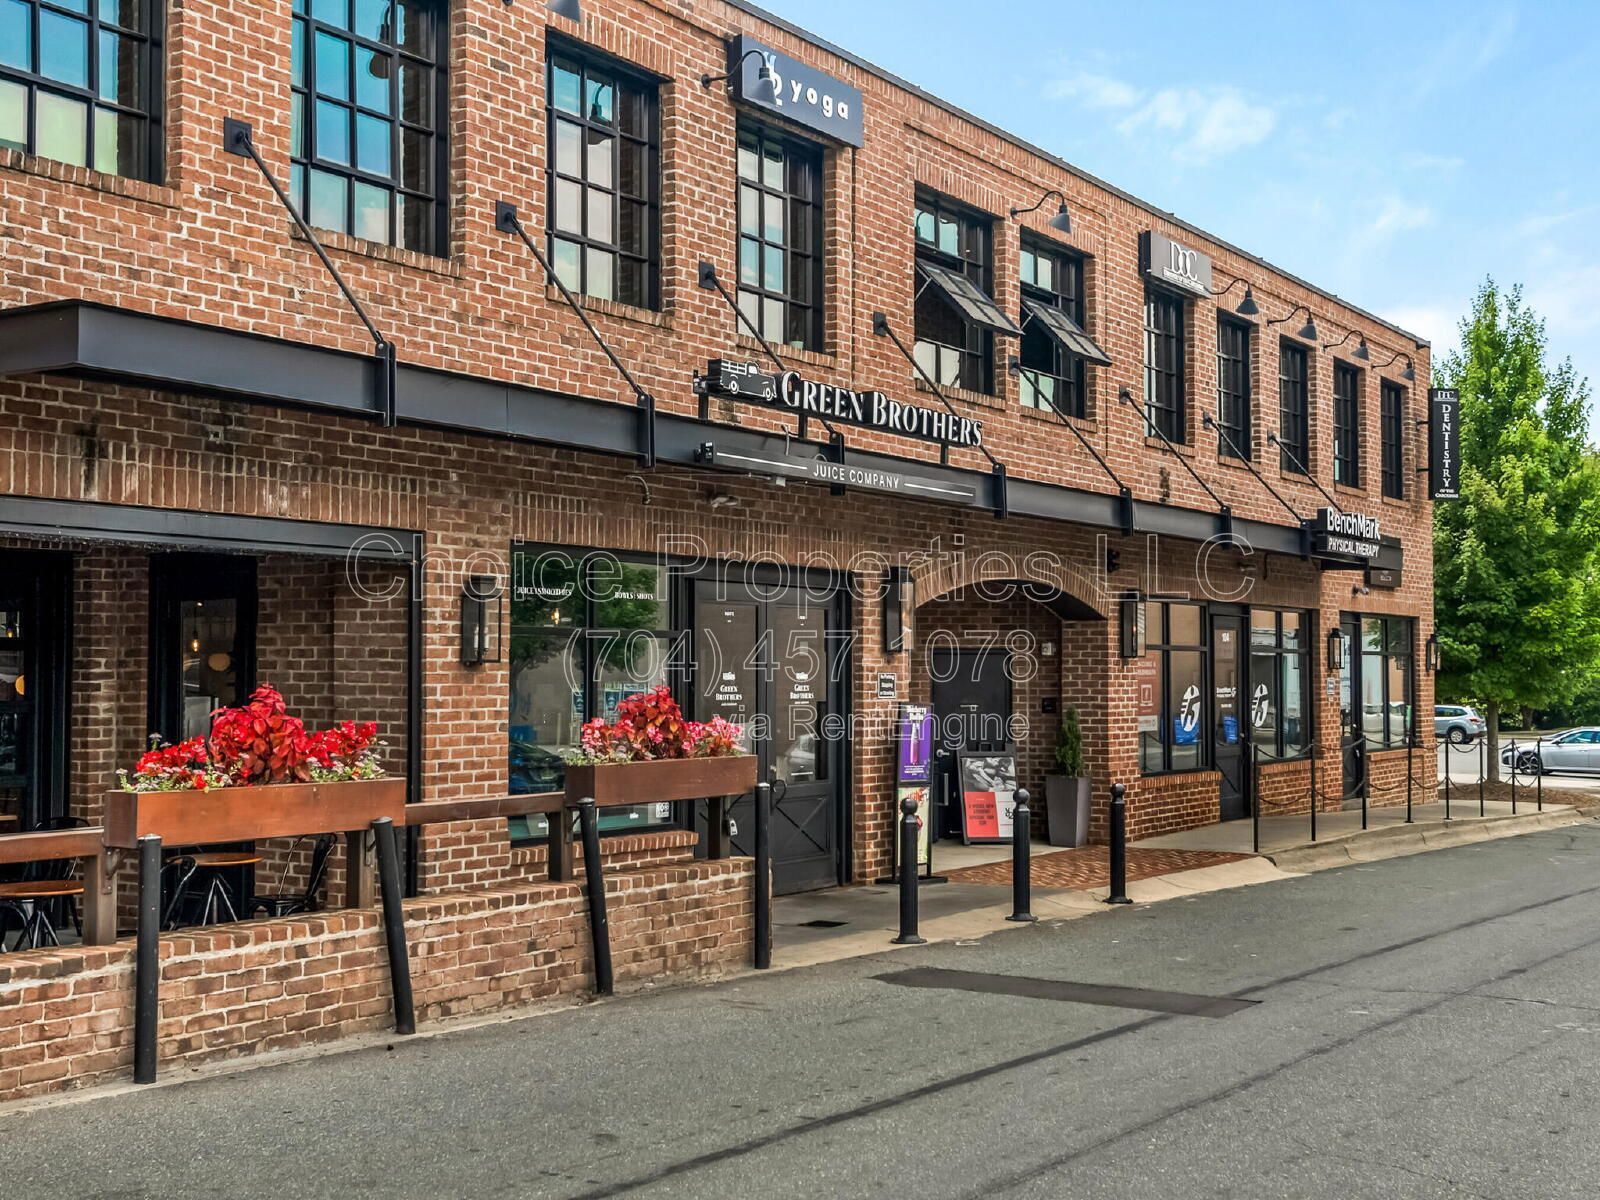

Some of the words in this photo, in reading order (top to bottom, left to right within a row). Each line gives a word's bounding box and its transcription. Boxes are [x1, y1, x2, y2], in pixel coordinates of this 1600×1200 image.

[791, 79, 849, 120] yoga
[781, 370, 864, 422] GREEN
[872, 390, 983, 447] BROTHERS
[1442, 404, 1452, 488] DENTISTRY
[812, 463, 846, 481] JUICE
[849, 469, 900, 489] COMPANY
[1327, 506, 1381, 541] BenchMark
[1328, 537, 1355, 554] PHYSICAL
[1355, 541, 1380, 558] THERAPY
